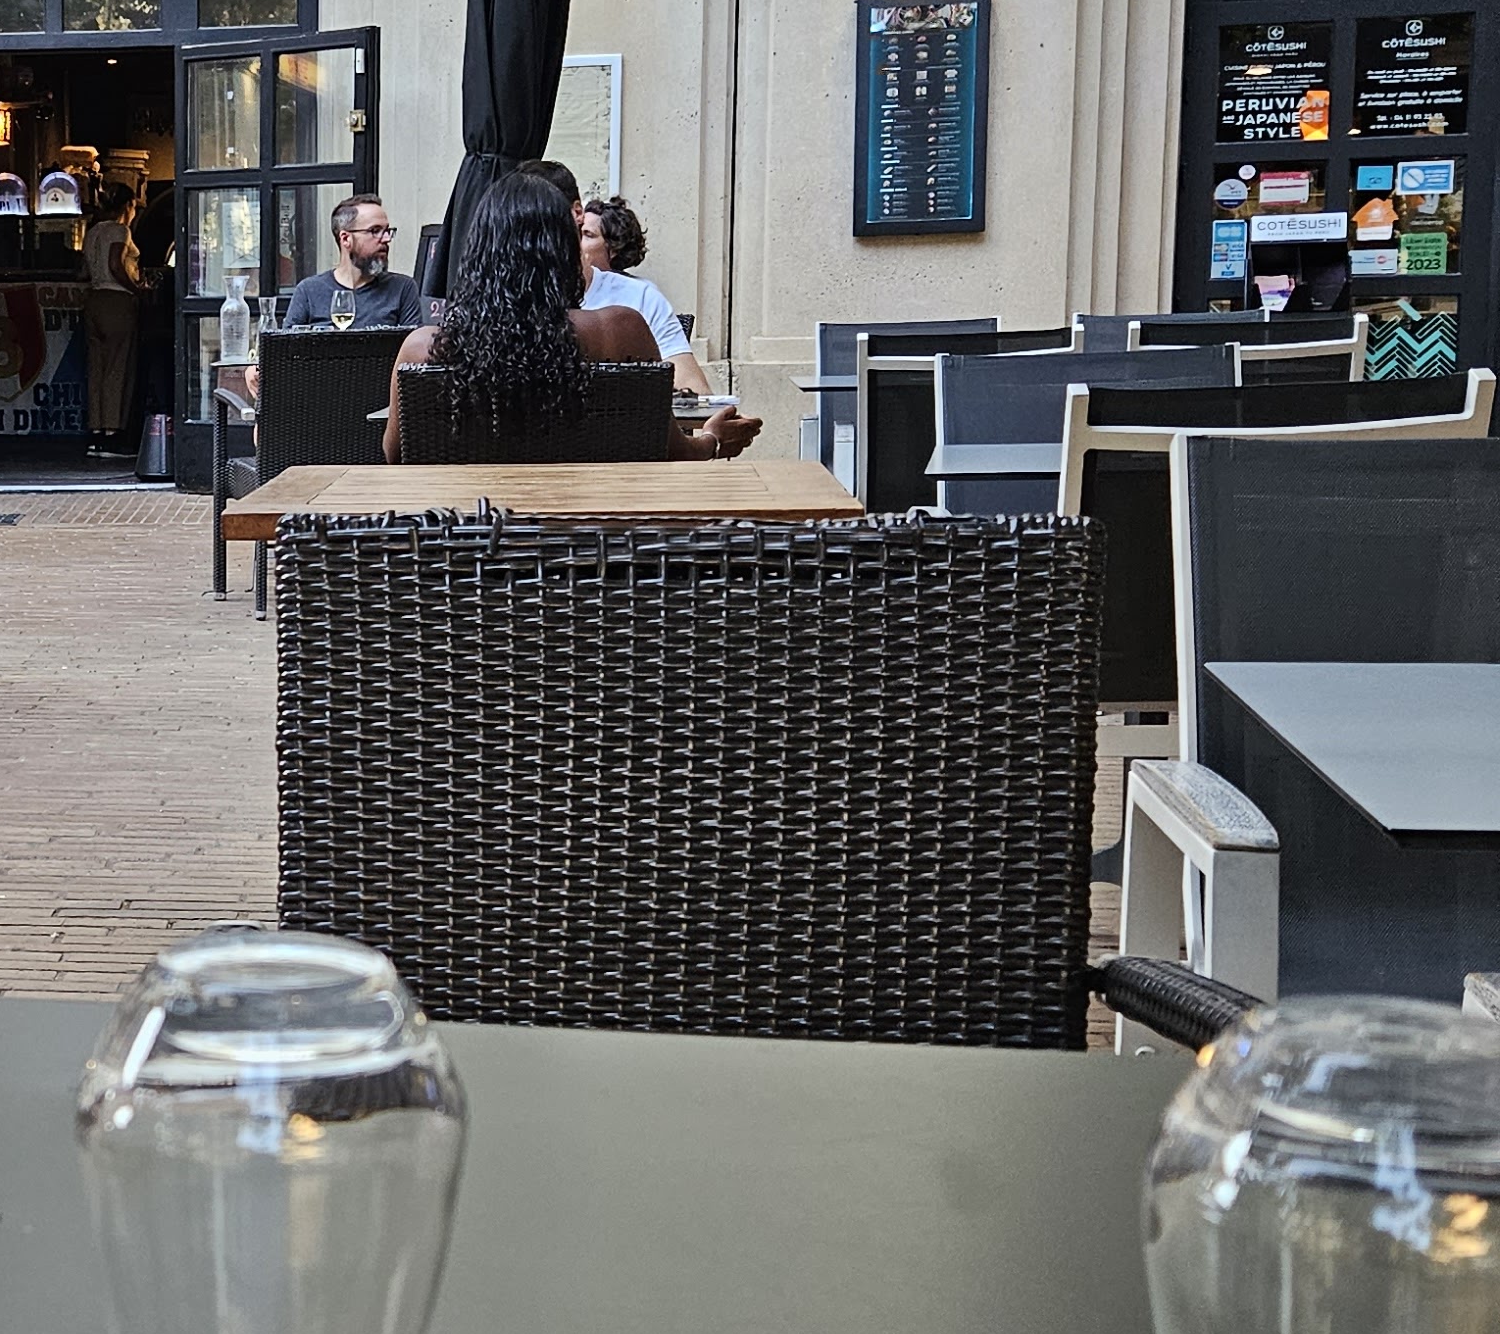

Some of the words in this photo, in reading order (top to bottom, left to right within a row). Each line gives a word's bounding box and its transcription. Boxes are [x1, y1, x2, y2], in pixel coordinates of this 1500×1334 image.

[1221, 96, 1325, 112] PERUVIAN
[1235, 110, 1325, 126] JAPANESE
[1243, 126, 1302, 140] STYLE
[1405, 258, 1442, 271] 2023
